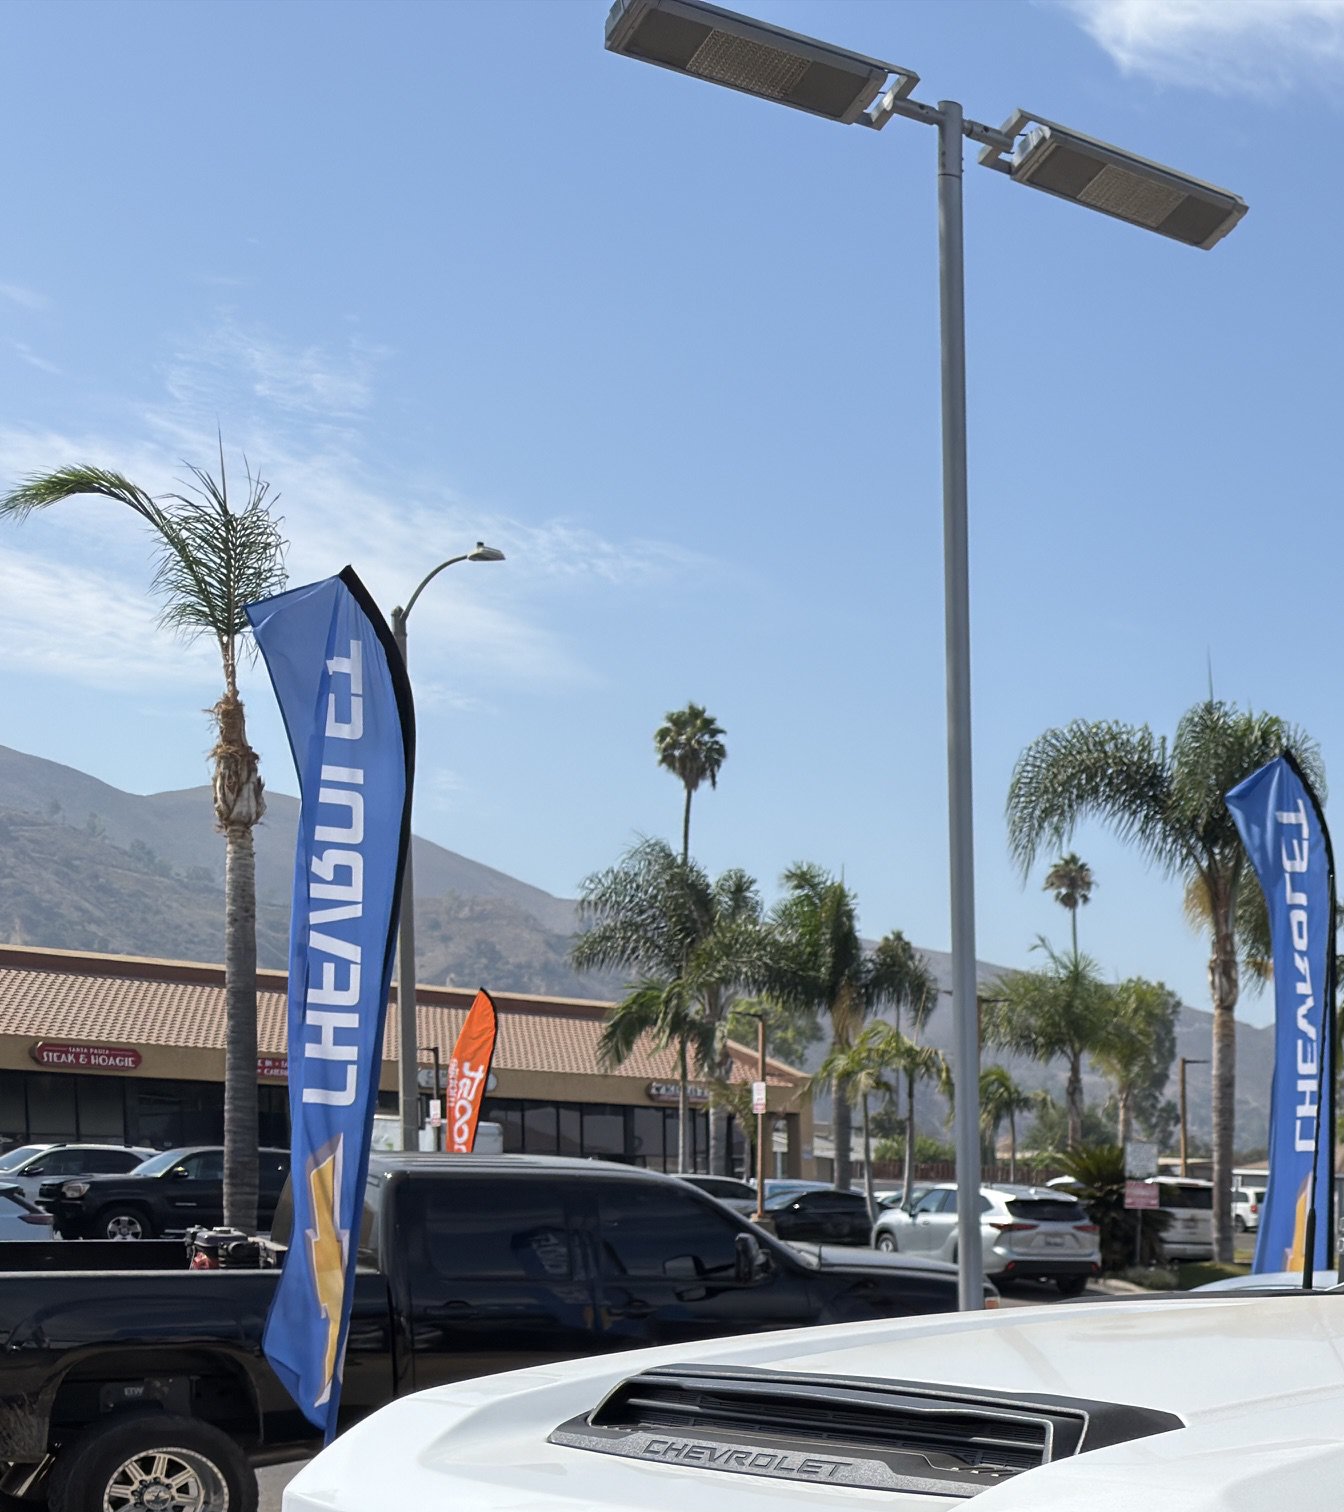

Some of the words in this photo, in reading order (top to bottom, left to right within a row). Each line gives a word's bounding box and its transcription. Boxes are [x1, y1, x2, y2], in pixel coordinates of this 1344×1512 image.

[43, 1051, 75, 1064] STEAK
[79, 1054, 88, 1064] &
[90, 1054, 136, 1067] HOAGIE
[642, 1438, 853, 1478] CHEVROLET
